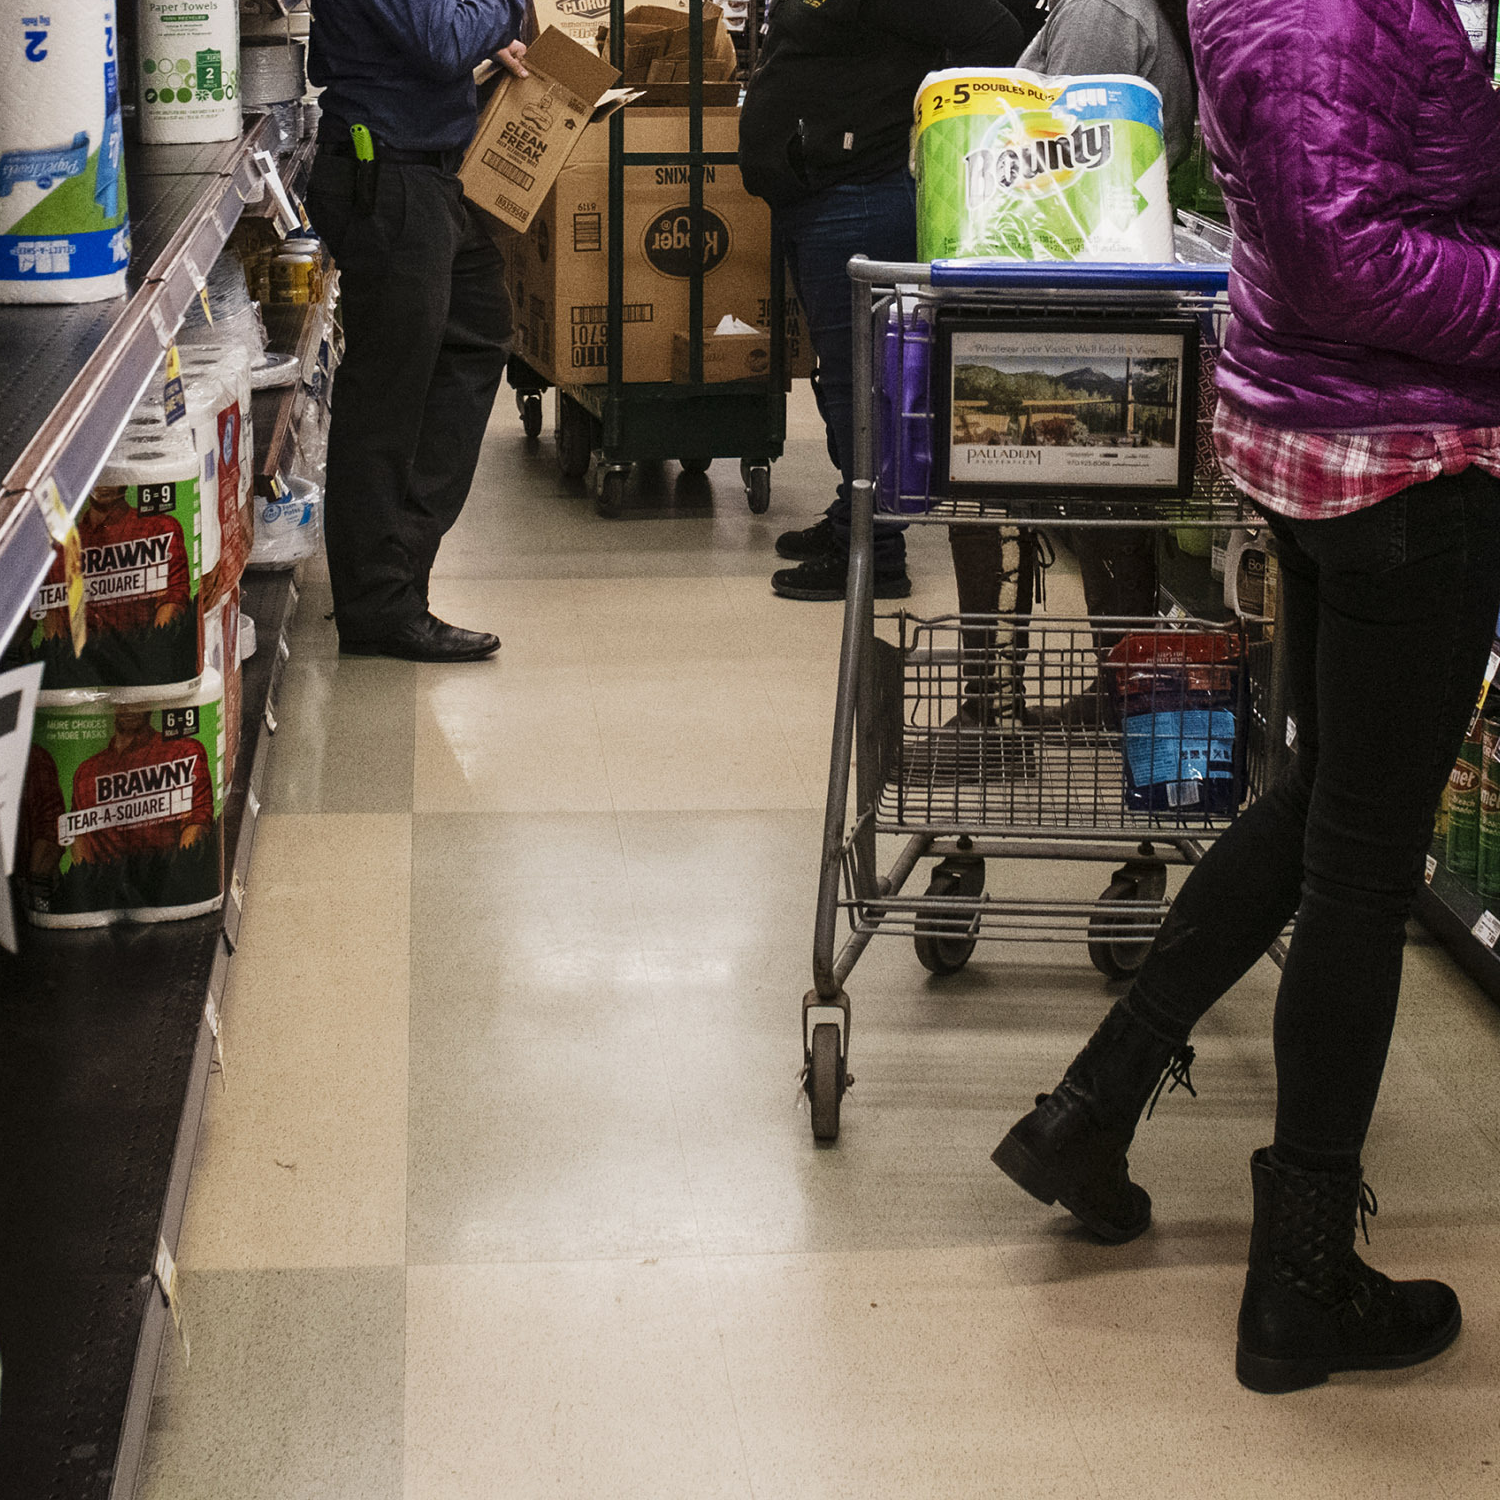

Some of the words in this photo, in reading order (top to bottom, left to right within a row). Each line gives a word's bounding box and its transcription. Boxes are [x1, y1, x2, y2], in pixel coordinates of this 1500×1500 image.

[149, 0, 180, 15] Paper
[182, 0, 218, 12] Towels
[24, 30, 48, 63] 2
[205, 67, 216, 80] 2
[972, 82, 1022, 96] DOUBLES
[505, 121, 548, 153] CLEAN
[500, 130, 543, 163] FREAK
[965, 123, 1112, 211] Bounty
[975, 344, 1019, 353] Whatever
[1022, 345, 1042, 355] your
[967, 449, 1042, 466] PALLADIUM
[70, 718, 108, 731] CHOICES
[57, 729, 81, 741] MORE
[82, 729, 108, 741] TASKS
[96, 760, 195, 802] BRAWNY
